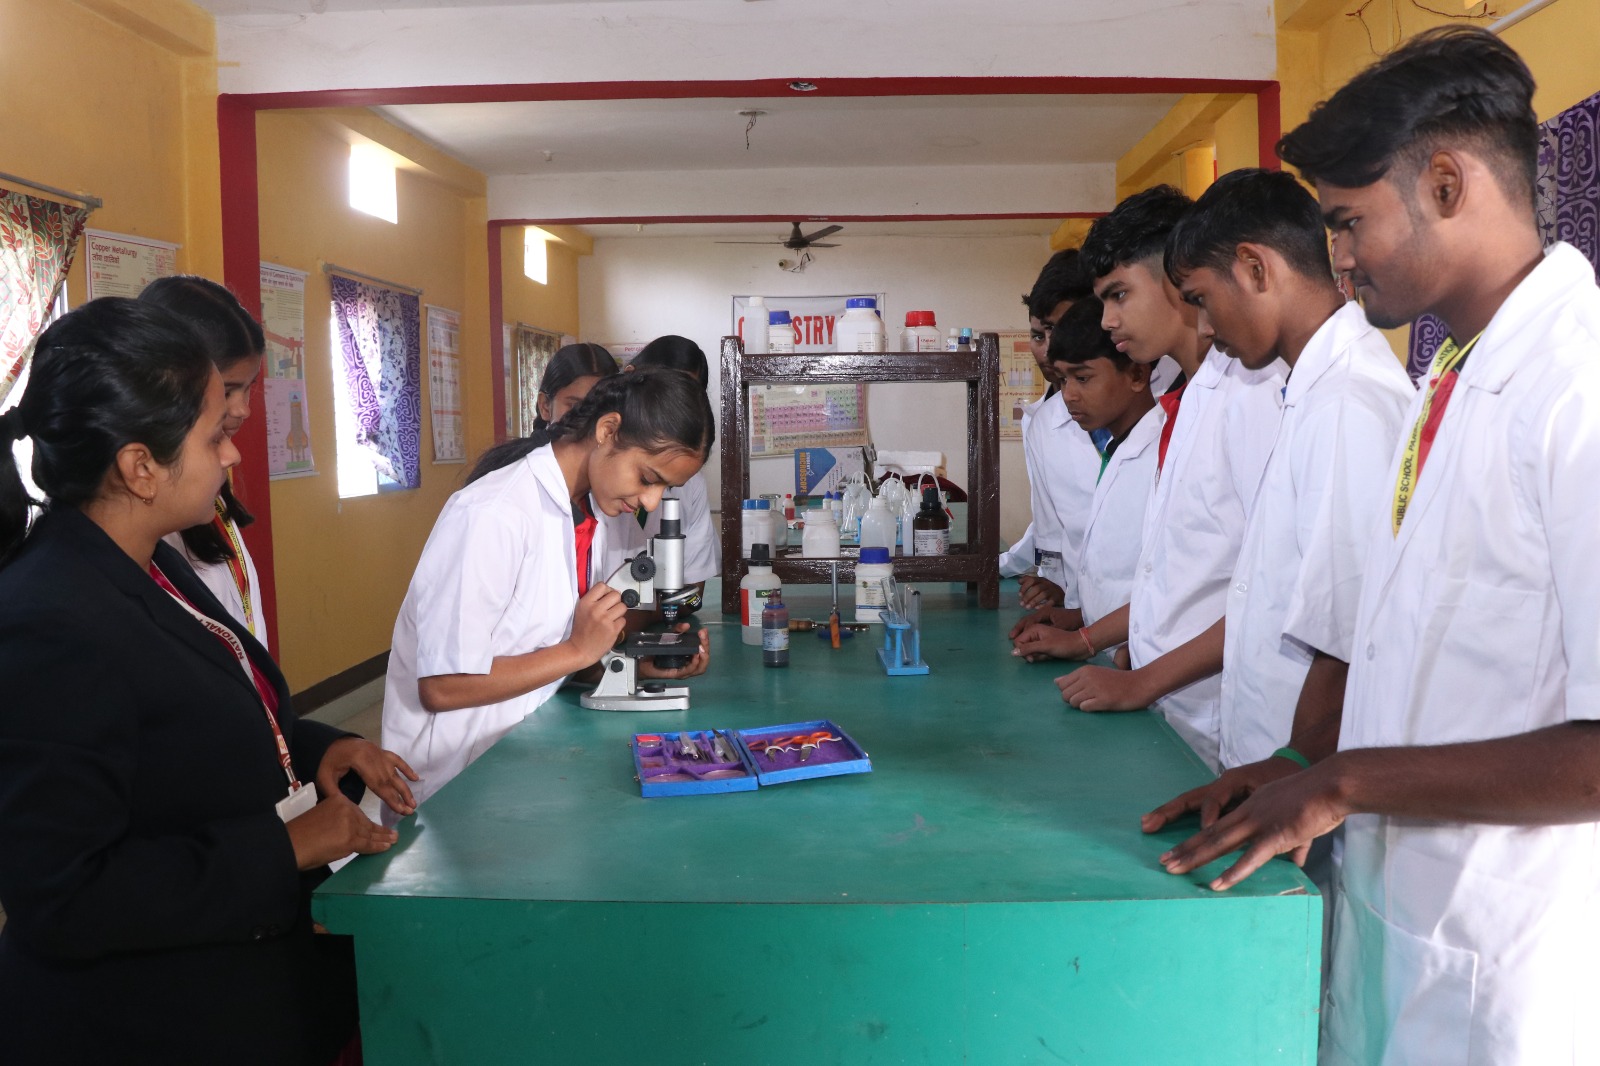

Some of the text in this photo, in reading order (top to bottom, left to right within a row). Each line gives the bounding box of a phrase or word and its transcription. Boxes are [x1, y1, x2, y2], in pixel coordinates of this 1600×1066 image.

[91, 241, 138, 259] Copper Metallurgy
[738, 315, 836, 345] CSTRY
[1436, 342, 1456, 368] NATION
[799, 451, 808, 494] MICROSCOPE
[205, 620, 245, 660] NATIONAL
